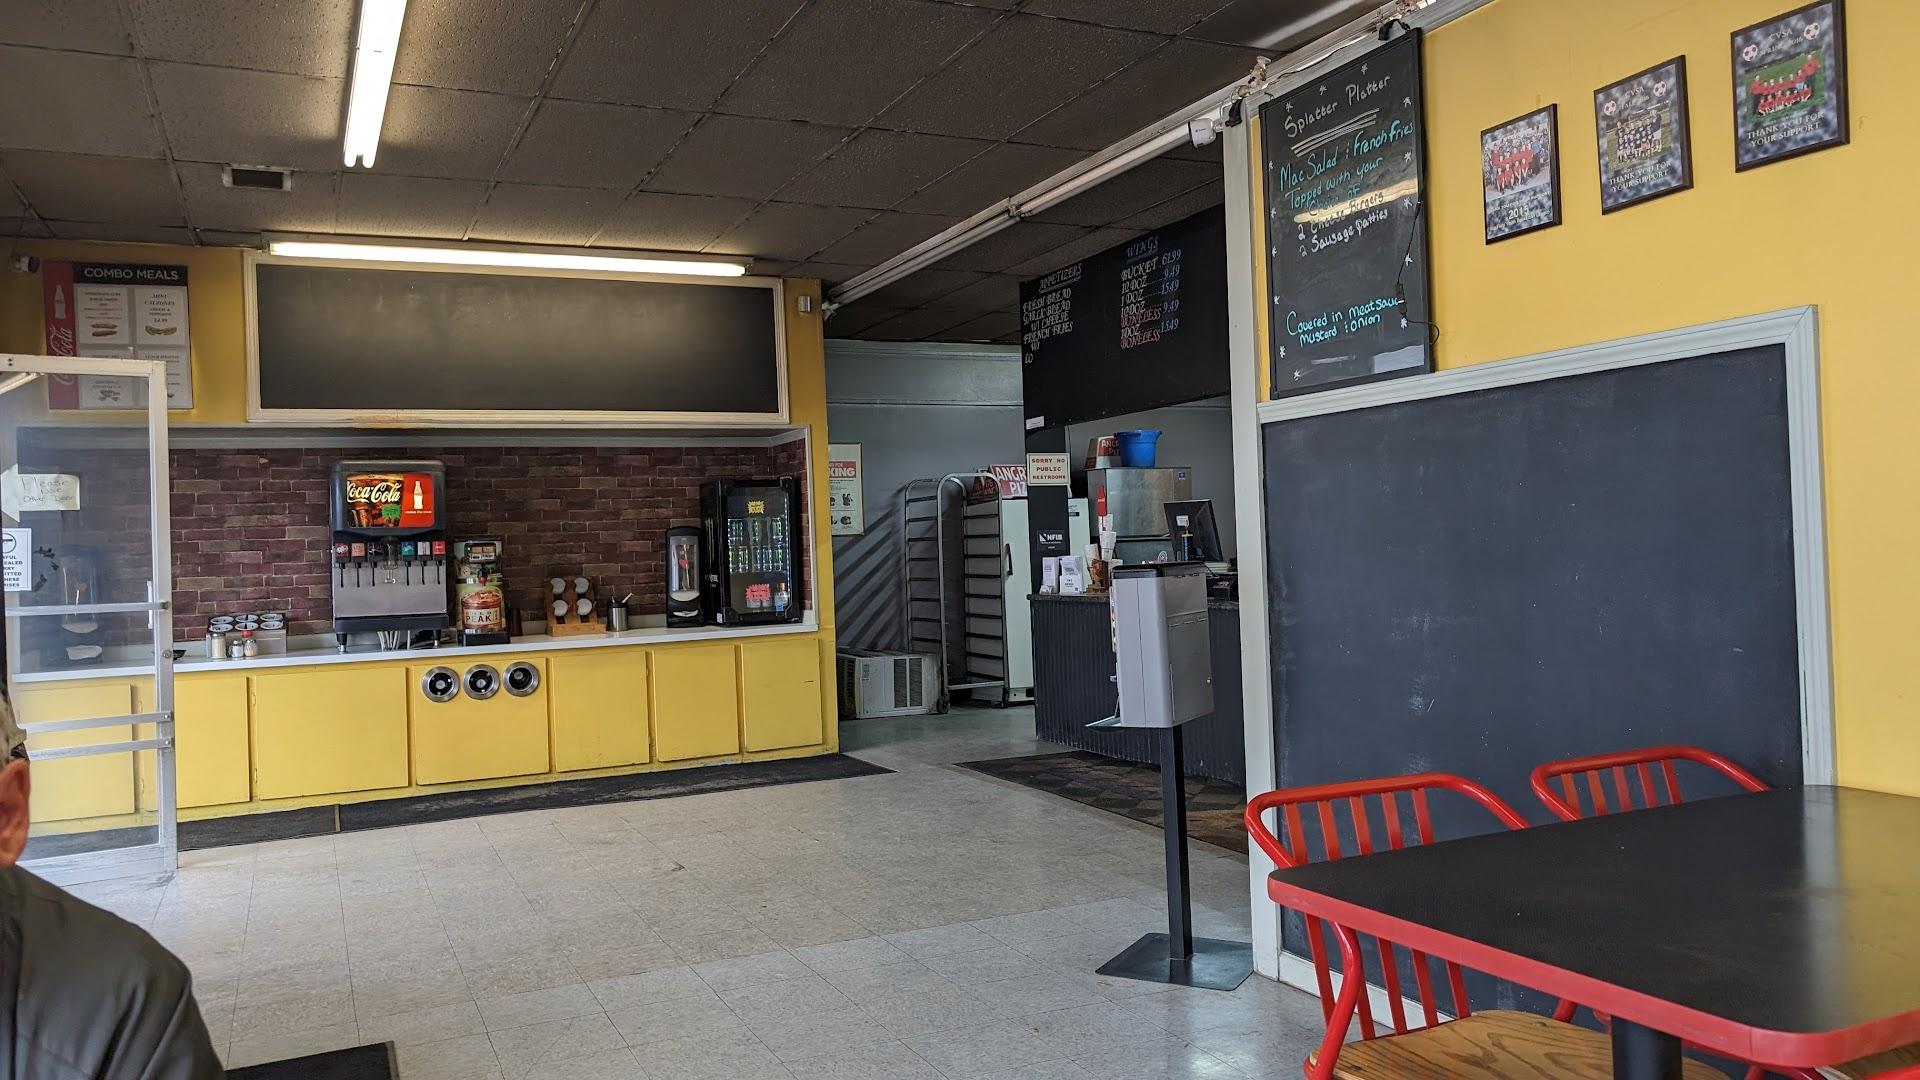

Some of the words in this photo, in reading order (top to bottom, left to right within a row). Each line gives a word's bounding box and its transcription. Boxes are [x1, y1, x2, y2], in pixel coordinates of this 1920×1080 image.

[1284, 102, 1338, 138] Splatter
[1345, 76, 1390, 106] Platter
[1748, 125, 1779, 139] THANK
[1782, 117, 1802, 128] YOU
[1806, 111, 1824, 122] FOR
[1751, 135, 1777, 147] YOUR
[1779, 122, 1820, 138] SUPPORT
[1280, 163, 1304, 191] Mac
[1306, 146, 1338, 180] Salad
[1610, 173, 1635, 185] THANK
[1637, 165, 1654, 177] YOU
[1656, 160, 1672, 169] FOR
[1285, 185, 1322, 209] Topped
[1326, 170, 1350, 191] with
[1356, 157, 1383, 178] your
[1612, 179, 1634, 192] YOUR
[1635, 170, 1668, 184] SUPPORT
[1298, 224, 1305, 241] 2
[1309, 209, 1345, 234] Cheese
[1127, 237, 1159, 257] WINGS
[1300, 245, 1307, 257] 2
[1311, 225, 1354, 253] Sausage
[84, 268, 133, 278] COMBO
[137, 270, 179, 280] MEALS
[1040, 263, 1082, 289] APPETIZERS
[1121, 257, 1158, 281] BUCKET
[1130, 275, 1147, 290] DOZ
[1023, 296, 1045, 312] FRESH
[1047, 288, 1071, 304] BREAD
[1126, 289, 1144, 303] DOZ
[1047, 300, 1070, 316] BREAD
[1121, 308, 1161, 328] BONELESS
[1287, 310, 1328, 336] Covered
[1332, 311, 1343, 323] in
[1375, 297, 1398, 310] Sauc
[1042, 311, 1069, 328] CHEESE
[1024, 327, 1050, 344] FRENCH
[1053, 321, 1073, 335] FRIES
[1121, 330, 1160, 349] BONELESS
[829, 467, 855, 477] KING
[996, 466, 1026, 481] ANGR
[346, 481, 403, 503] Coca-Cola
[1009, 481, 1027, 494] PIZ
